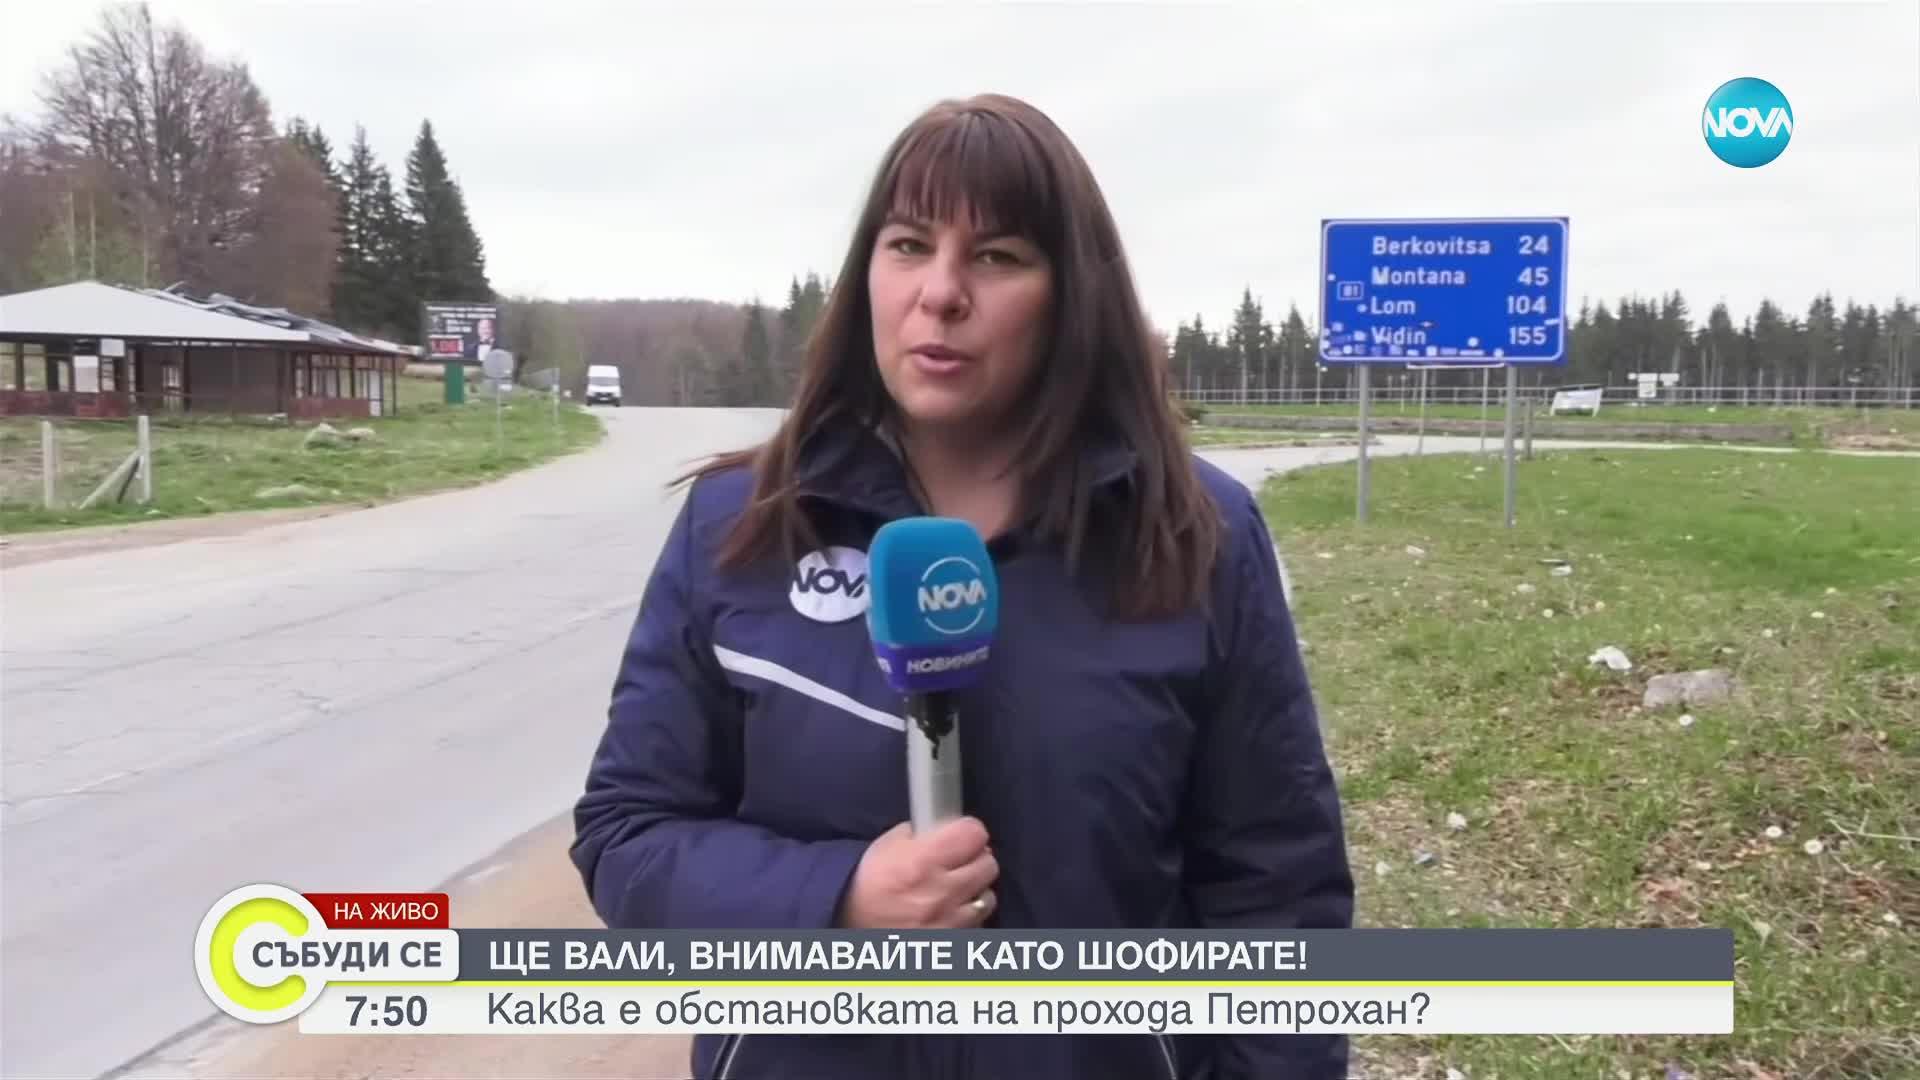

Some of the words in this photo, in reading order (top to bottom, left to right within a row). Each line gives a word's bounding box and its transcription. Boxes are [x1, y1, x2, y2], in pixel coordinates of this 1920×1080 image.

[1372, 236, 1491, 256] Berkovitsa
[1518, 235, 1549, 255] 24
[1371, 266, 1466, 286] Montana
[1517, 267, 1550, 286] 45
[1371, 296, 1417, 315] Lom
[1506, 295, 1547, 315] 104
[1371, 325, 1427, 345] Vidin
[1508, 326, 1547, 345] 155
[917, 578, 988, 613] NOVA
